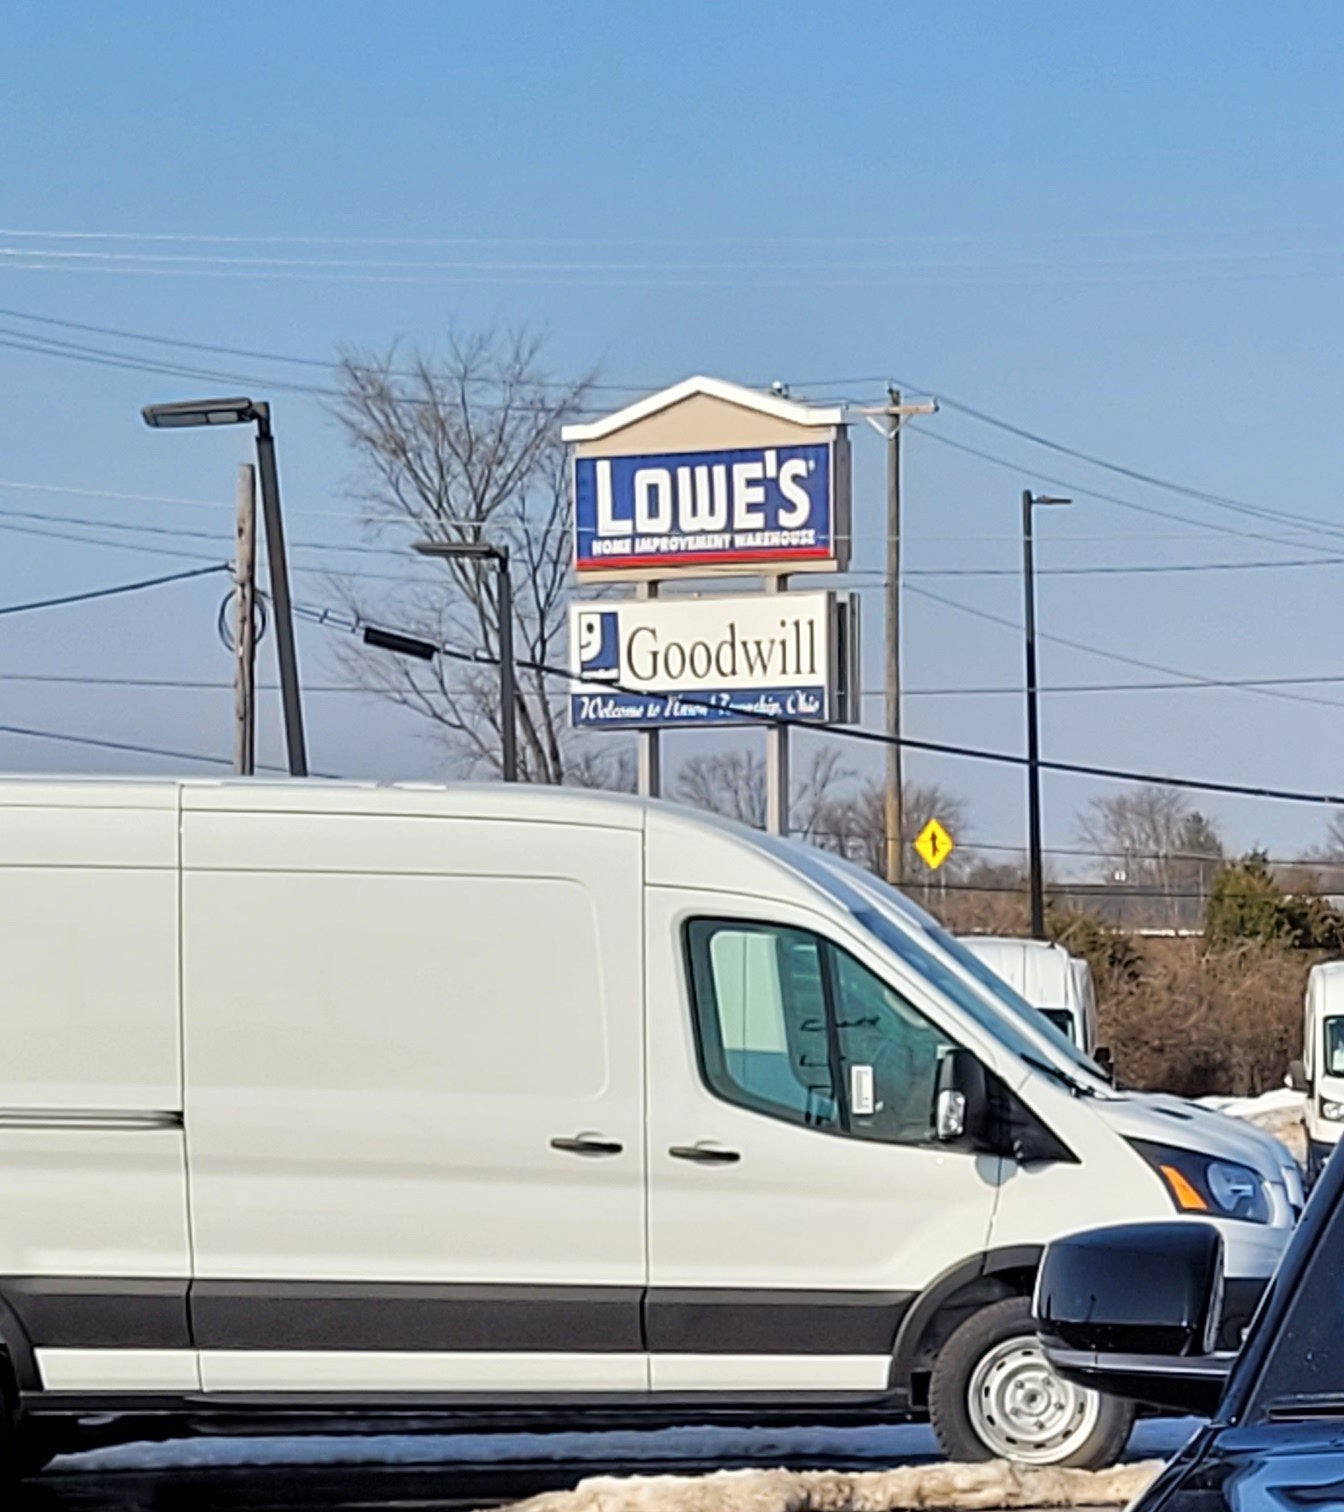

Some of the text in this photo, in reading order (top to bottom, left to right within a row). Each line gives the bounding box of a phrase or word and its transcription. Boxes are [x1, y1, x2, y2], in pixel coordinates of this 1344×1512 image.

[595, 450, 811, 538] LOWE'S
[592, 528, 816, 556] HOME IMPROVEMENT WAREHOUSE
[626, 618, 818, 682] Goodwill
